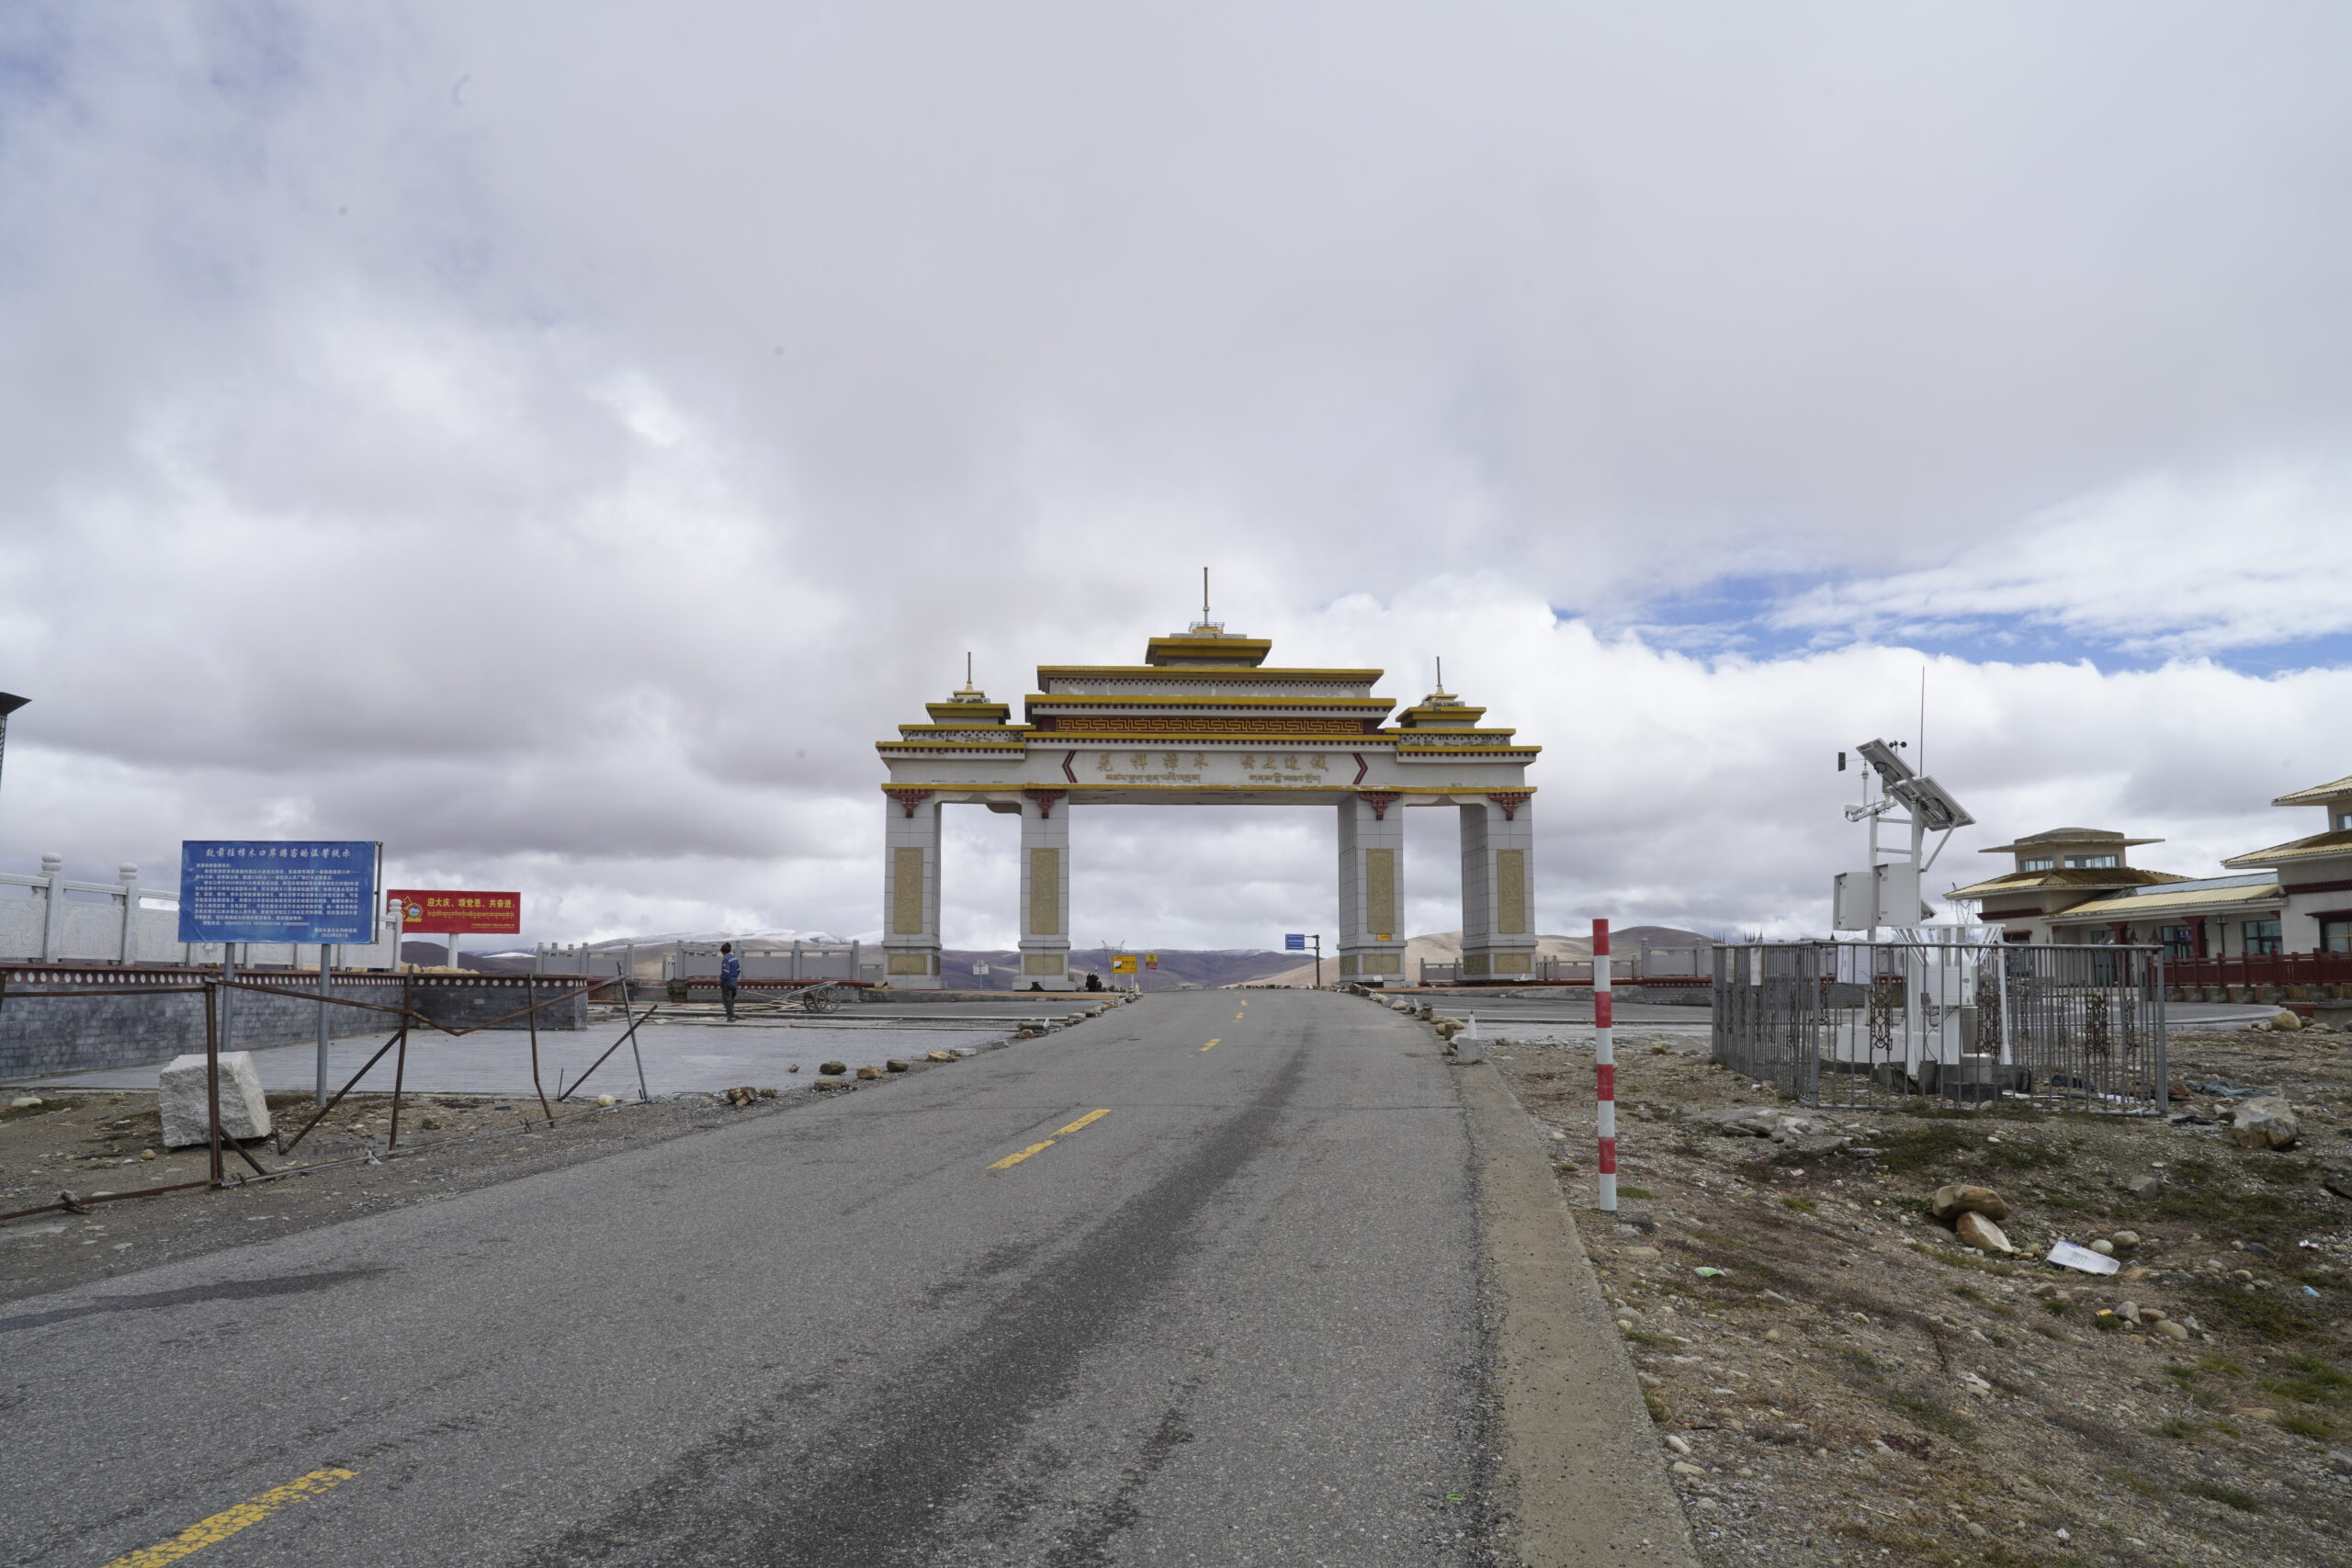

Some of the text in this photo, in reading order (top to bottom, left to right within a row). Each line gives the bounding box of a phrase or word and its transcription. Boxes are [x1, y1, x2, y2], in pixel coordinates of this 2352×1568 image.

[1096, 751, 1209, 772] 花样樟木
[206, 847, 351, 858] 致前往樟木口岸游客的温馨提示
